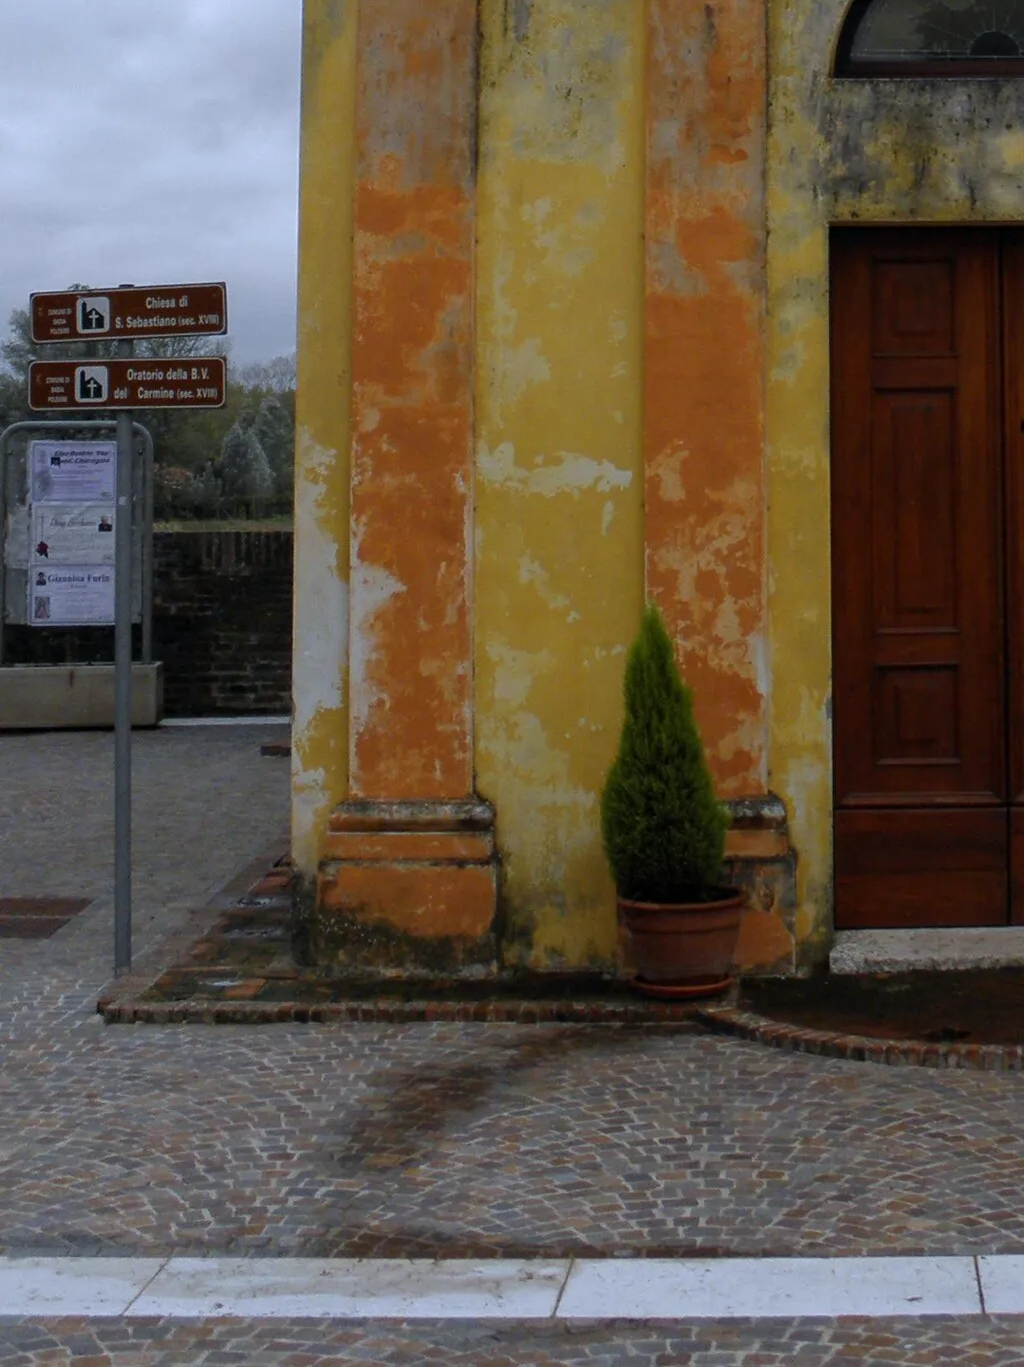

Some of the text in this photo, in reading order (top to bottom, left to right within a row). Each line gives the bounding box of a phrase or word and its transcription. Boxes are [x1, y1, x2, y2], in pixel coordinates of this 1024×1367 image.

[145, 295, 188, 309] Chiesa di
[115, 314, 220, 329] S. Sebastiano (sec. XVIII)
[127, 368, 164, 381] Oratorio
[166, 367, 188, 379] della
[114, 386, 218, 399] del Carmine (sec. XVIII)
